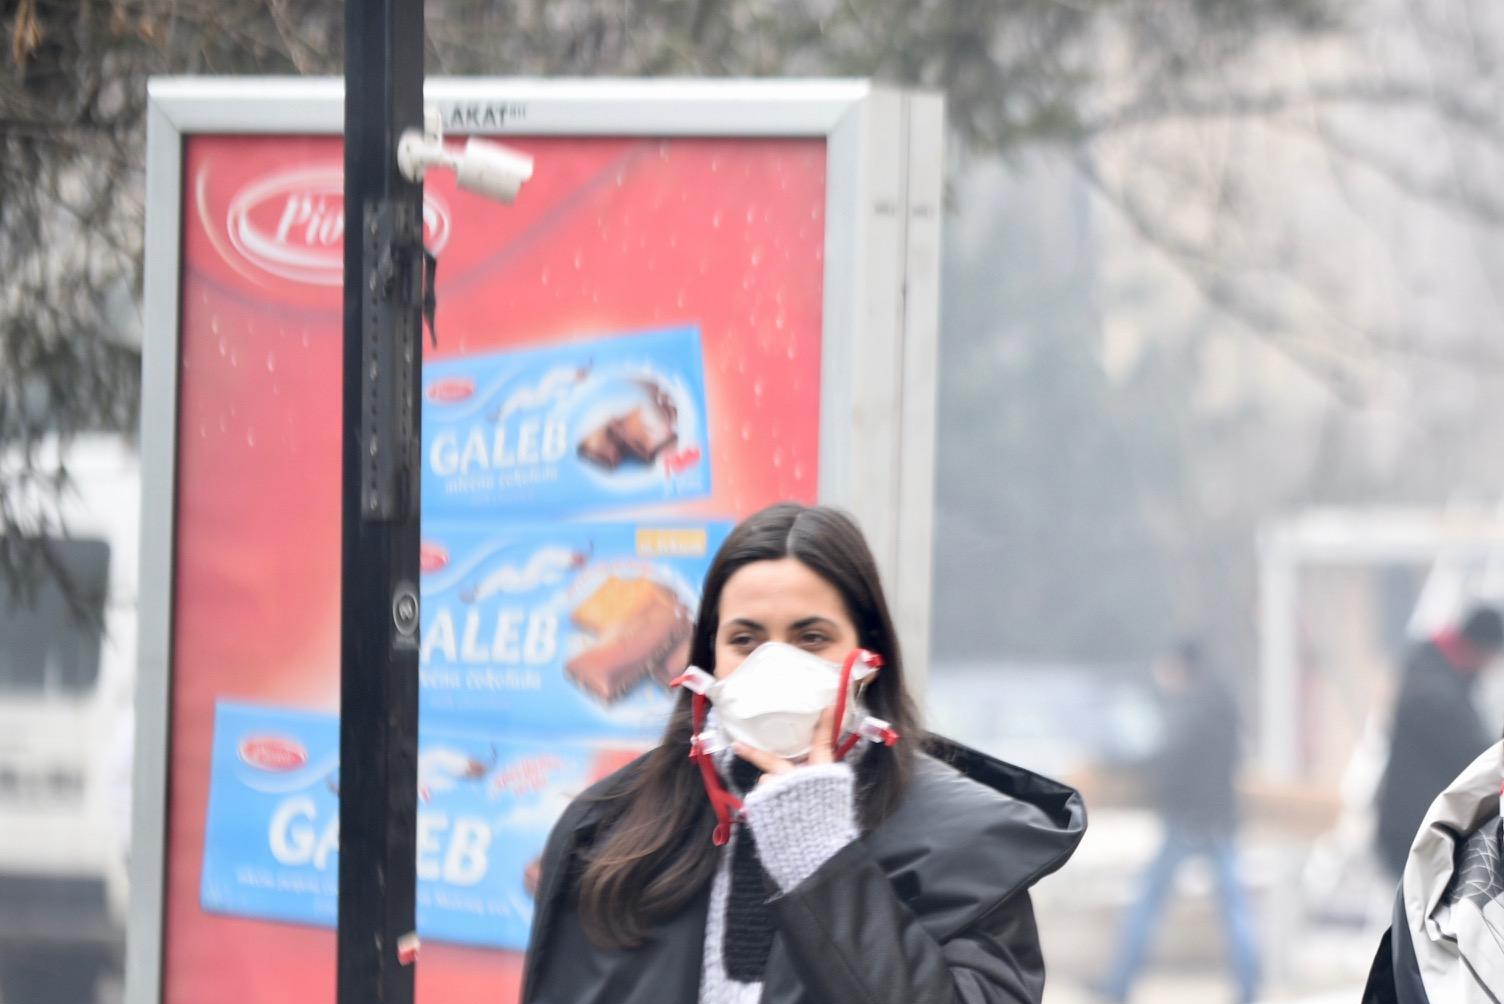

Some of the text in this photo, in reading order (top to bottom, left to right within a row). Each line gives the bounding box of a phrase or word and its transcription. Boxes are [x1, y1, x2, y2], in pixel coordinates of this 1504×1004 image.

[442, 104, 507, 129] AKAT
[274, 190, 344, 246] Pio
[429, 417, 567, 477] GALEB
[420, 605, 558, 666] ALEB
[268, 793, 493, 887] GAEB
